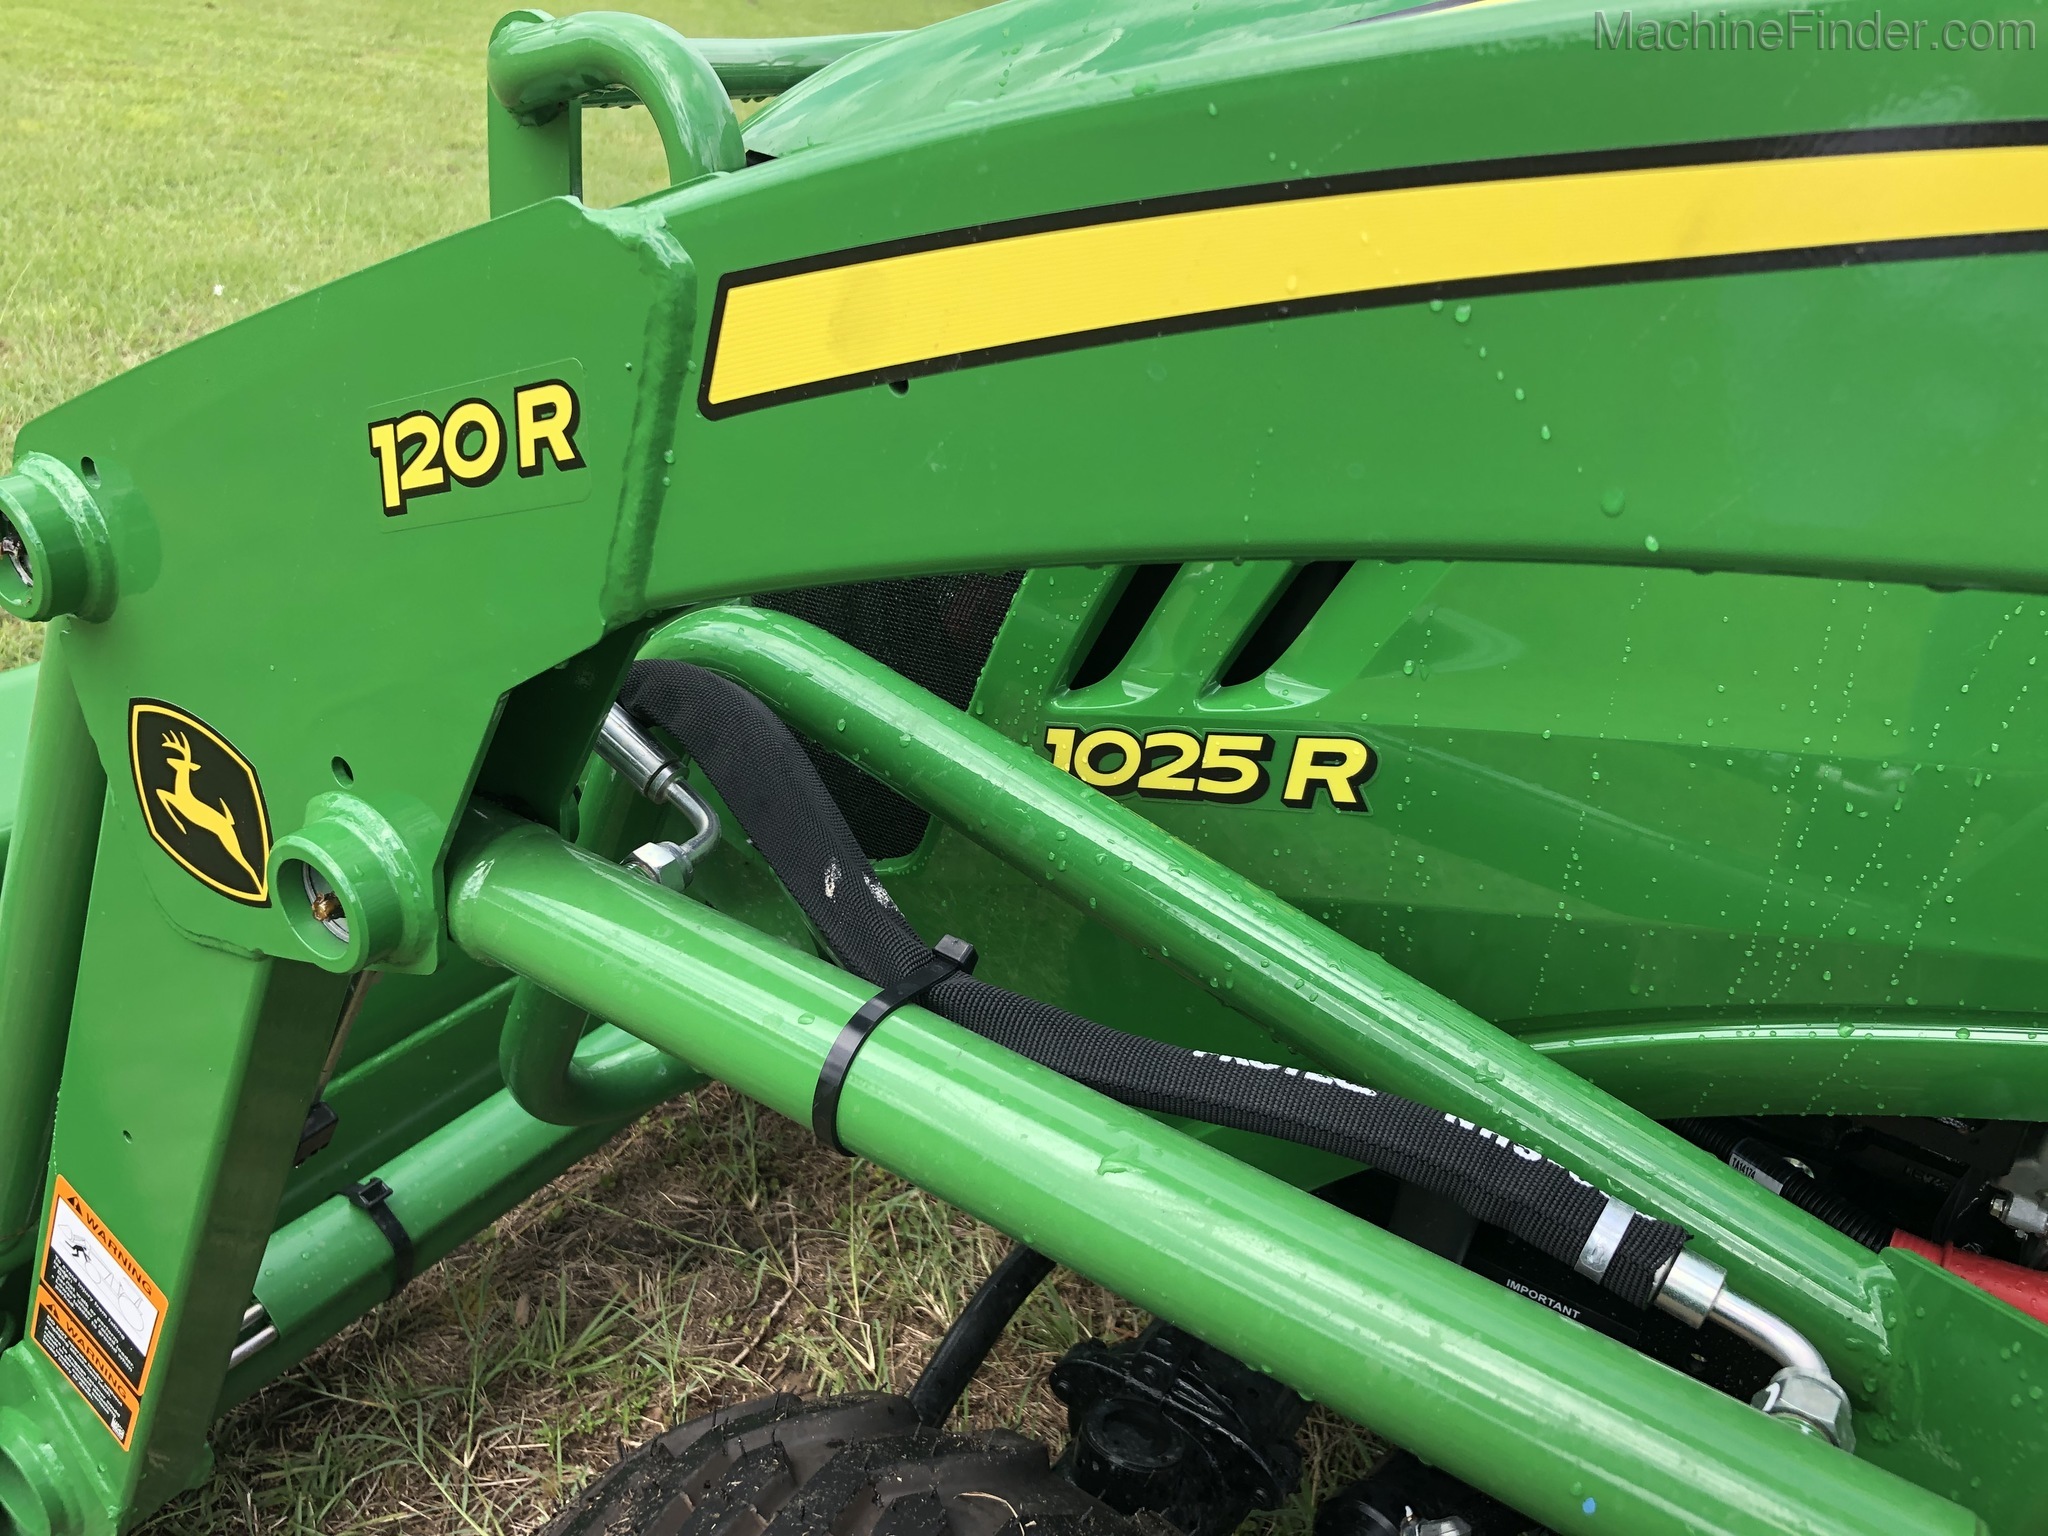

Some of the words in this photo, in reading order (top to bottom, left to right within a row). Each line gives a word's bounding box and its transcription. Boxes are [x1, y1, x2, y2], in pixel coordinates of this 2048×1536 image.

[368, 396, 508, 518] 120
[513, 378, 587, 479] R
[1043, 726, 1276, 805] 1025
[1280, 734, 1371, 813] R
[85, 1212, 153, 1297] WARNING
[1505, 1278, 1581, 1319] IMPORTANT
[66, 1321, 127, 1400] WARNING
